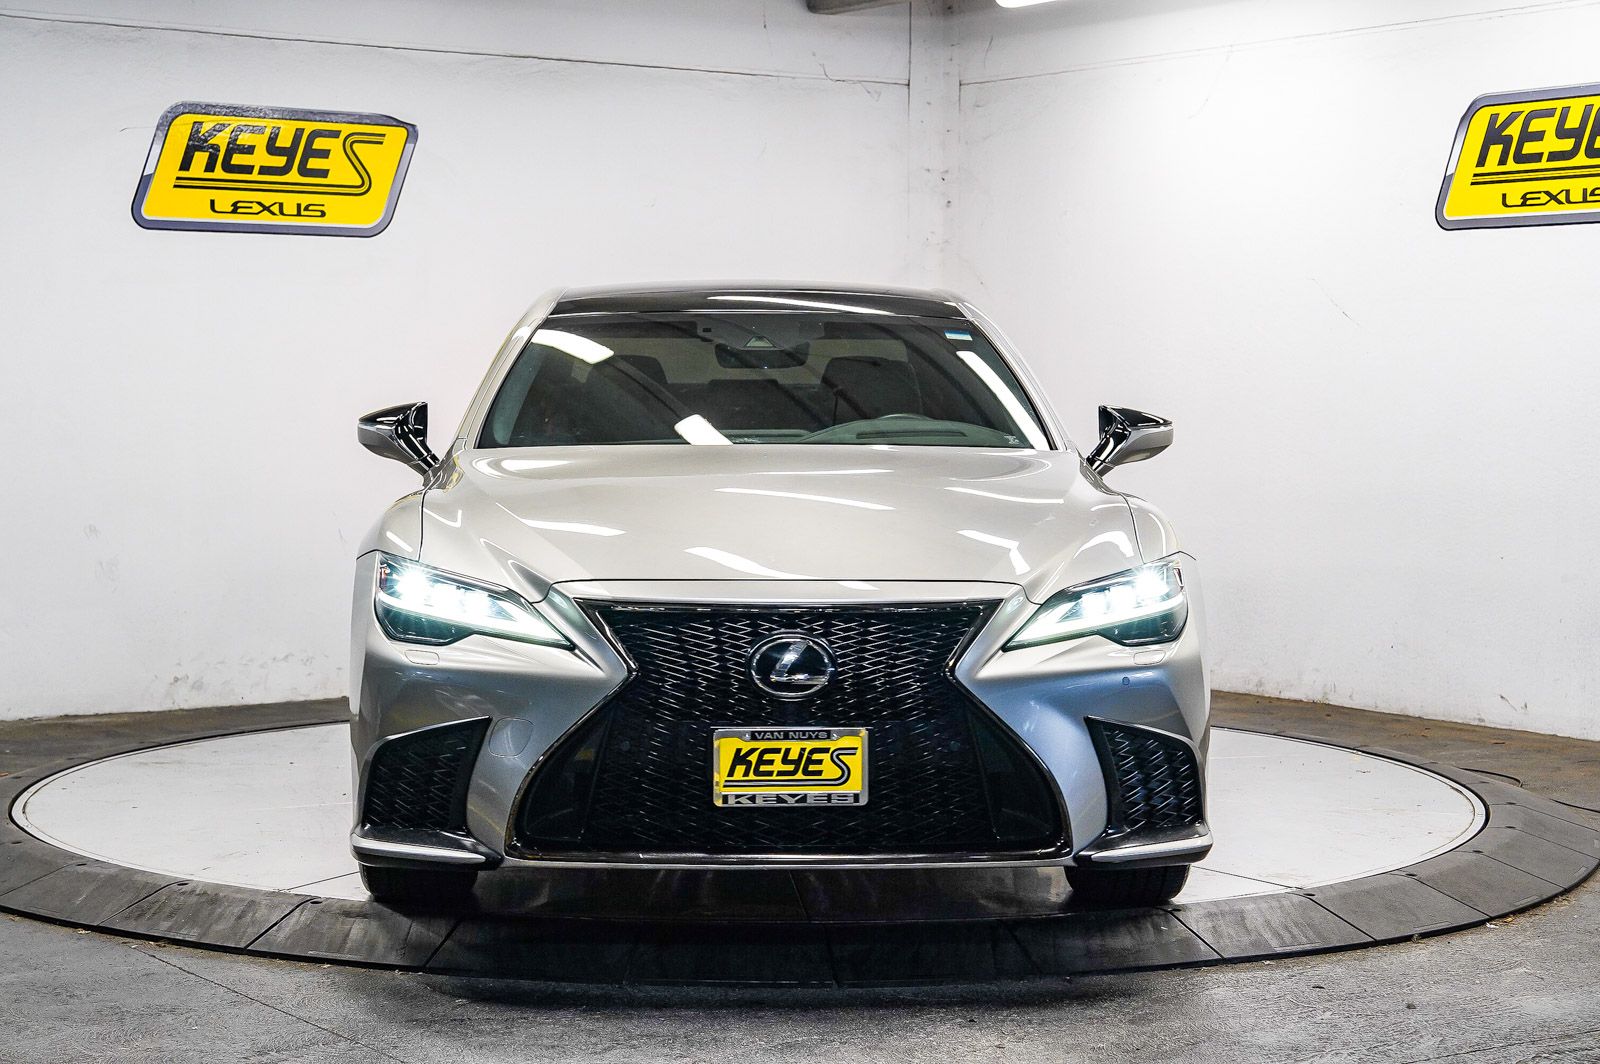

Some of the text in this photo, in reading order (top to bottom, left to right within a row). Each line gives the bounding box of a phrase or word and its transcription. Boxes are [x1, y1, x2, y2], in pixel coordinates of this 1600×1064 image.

[175, 121, 386, 196] KEYES
[210, 199, 326, 218] LEXUS
[755, 731, 828, 740] VAN NUYS
[725, 747, 858, 785] KEYES
[727, 794, 854, 804] KEYES
